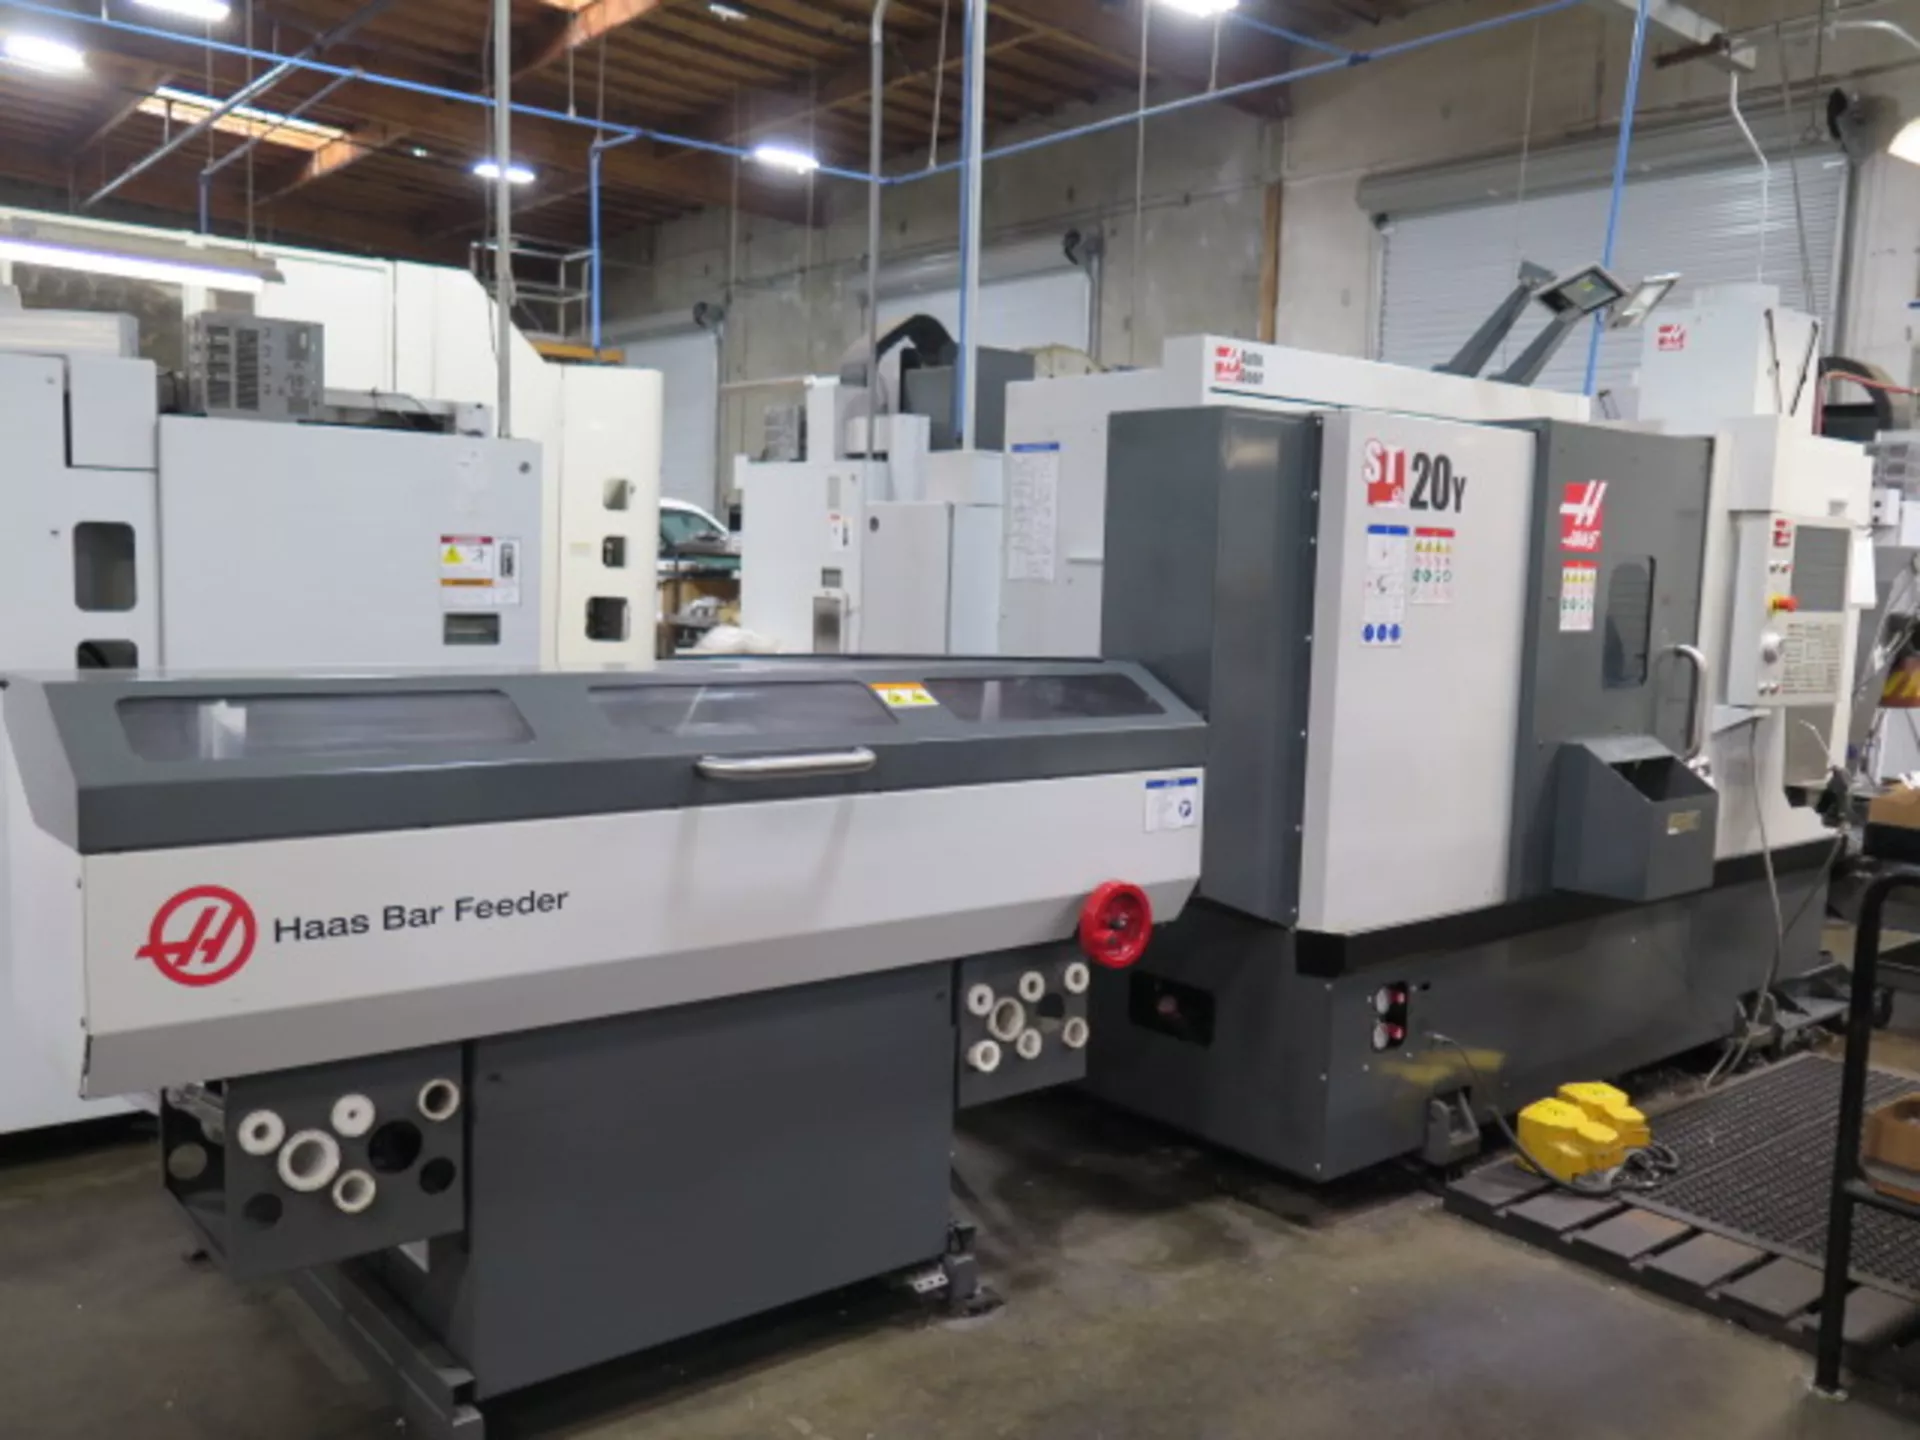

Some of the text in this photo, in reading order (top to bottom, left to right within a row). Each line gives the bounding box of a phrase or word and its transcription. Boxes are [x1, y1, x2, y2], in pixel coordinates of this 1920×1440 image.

[274, 890, 569, 943] Haas Bar Feeder
